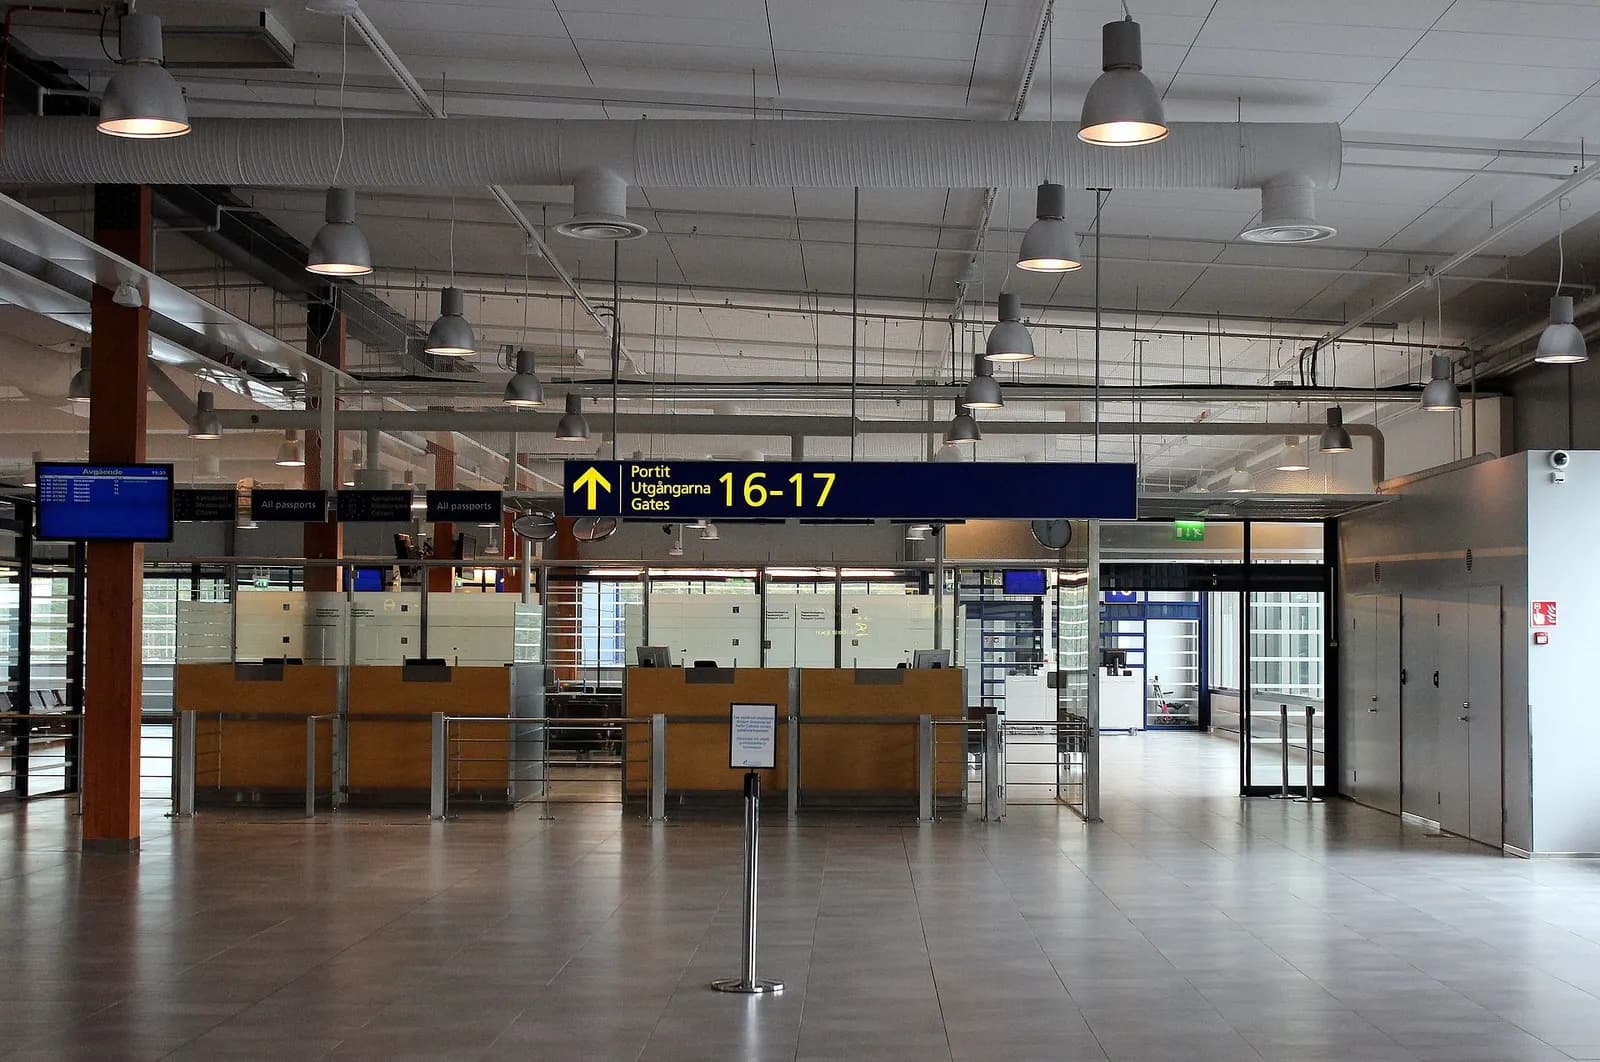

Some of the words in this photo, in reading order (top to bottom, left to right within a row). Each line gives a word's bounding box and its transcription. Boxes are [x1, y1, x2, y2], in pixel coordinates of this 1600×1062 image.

[631, 465, 671, 478] Portit
[631, 481, 711, 497] Utgångarna
[719, 472, 836, 507] 16-17
[261, 499, 274, 509] All
[275, 500, 316, 512] passports
[436, 501, 449, 510] All
[451, 502, 492, 513] passports
[631, 498, 670, 511] Gates
